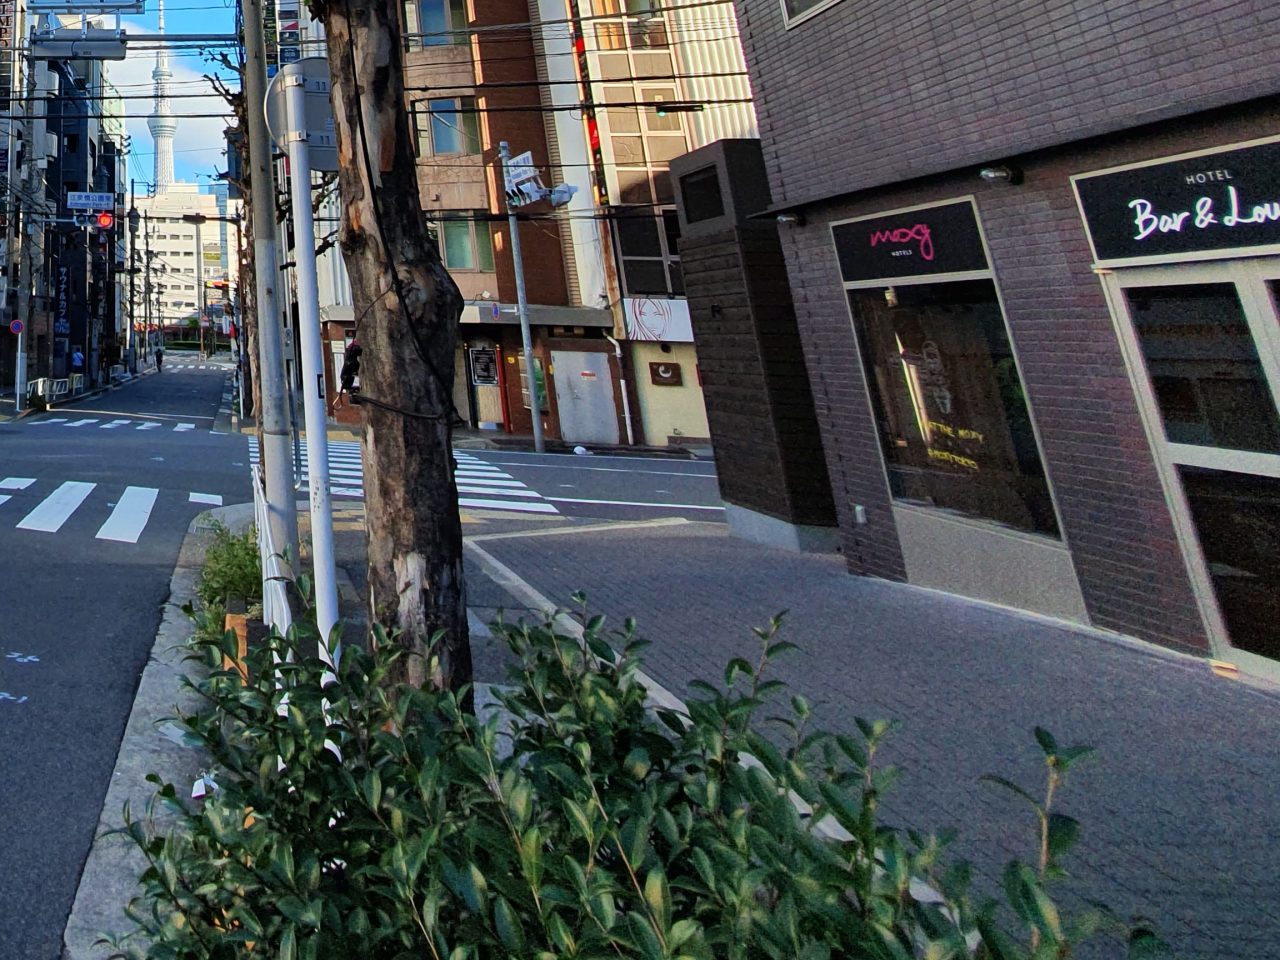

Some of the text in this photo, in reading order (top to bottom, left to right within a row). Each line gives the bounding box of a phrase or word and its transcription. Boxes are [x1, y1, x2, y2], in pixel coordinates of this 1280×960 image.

[1185, 169, 1233, 185] HOTEL
[1128, 198, 1190, 240] Bar
[1194, 196, 1218, 228] &
[870, 224, 934, 260] moxy
